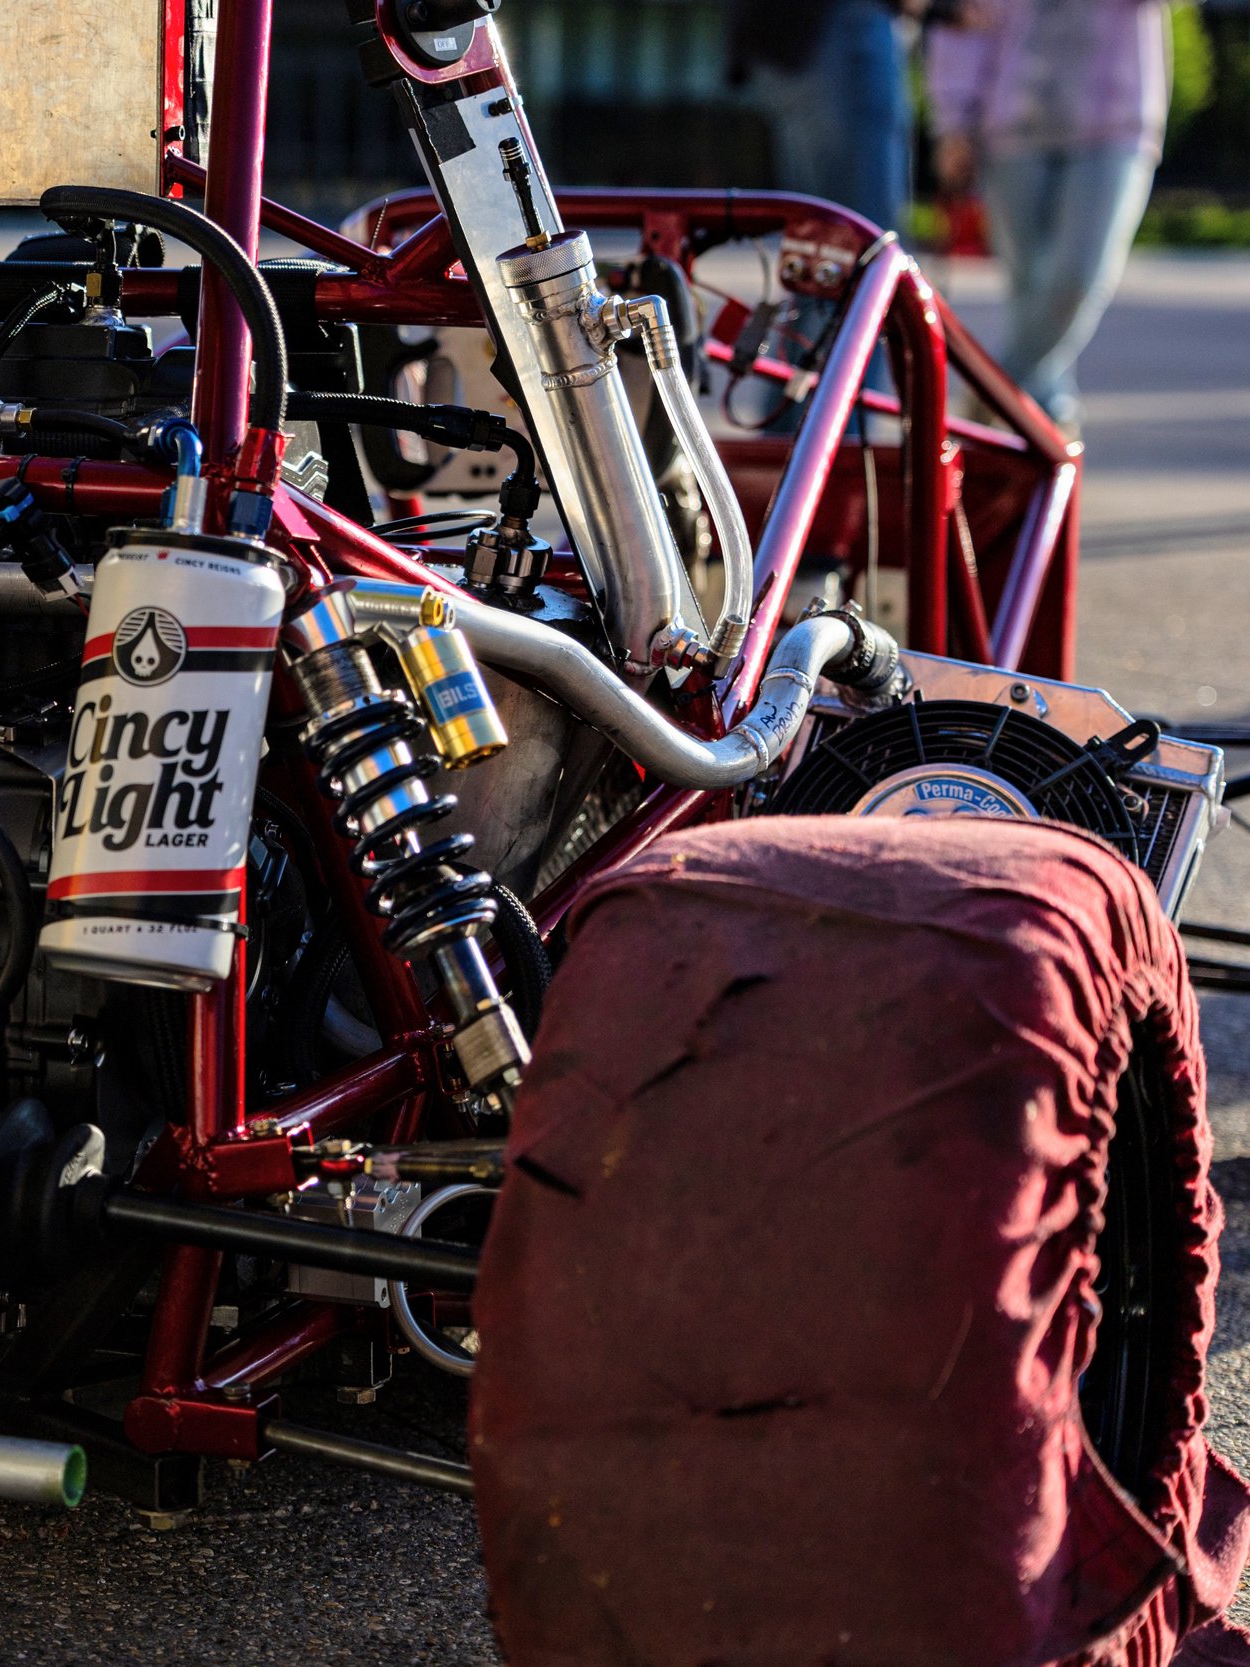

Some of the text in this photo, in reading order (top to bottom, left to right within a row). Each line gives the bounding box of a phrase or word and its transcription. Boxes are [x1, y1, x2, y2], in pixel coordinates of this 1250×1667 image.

[174, 557, 204, 568] CINCY
[70, 694, 230, 777] Cincy
[60, 761, 224, 853] Light
[145, 832, 209, 848] LAGER
[90, 925, 131, 935] QUART
[147, 926, 163, 934] 32
